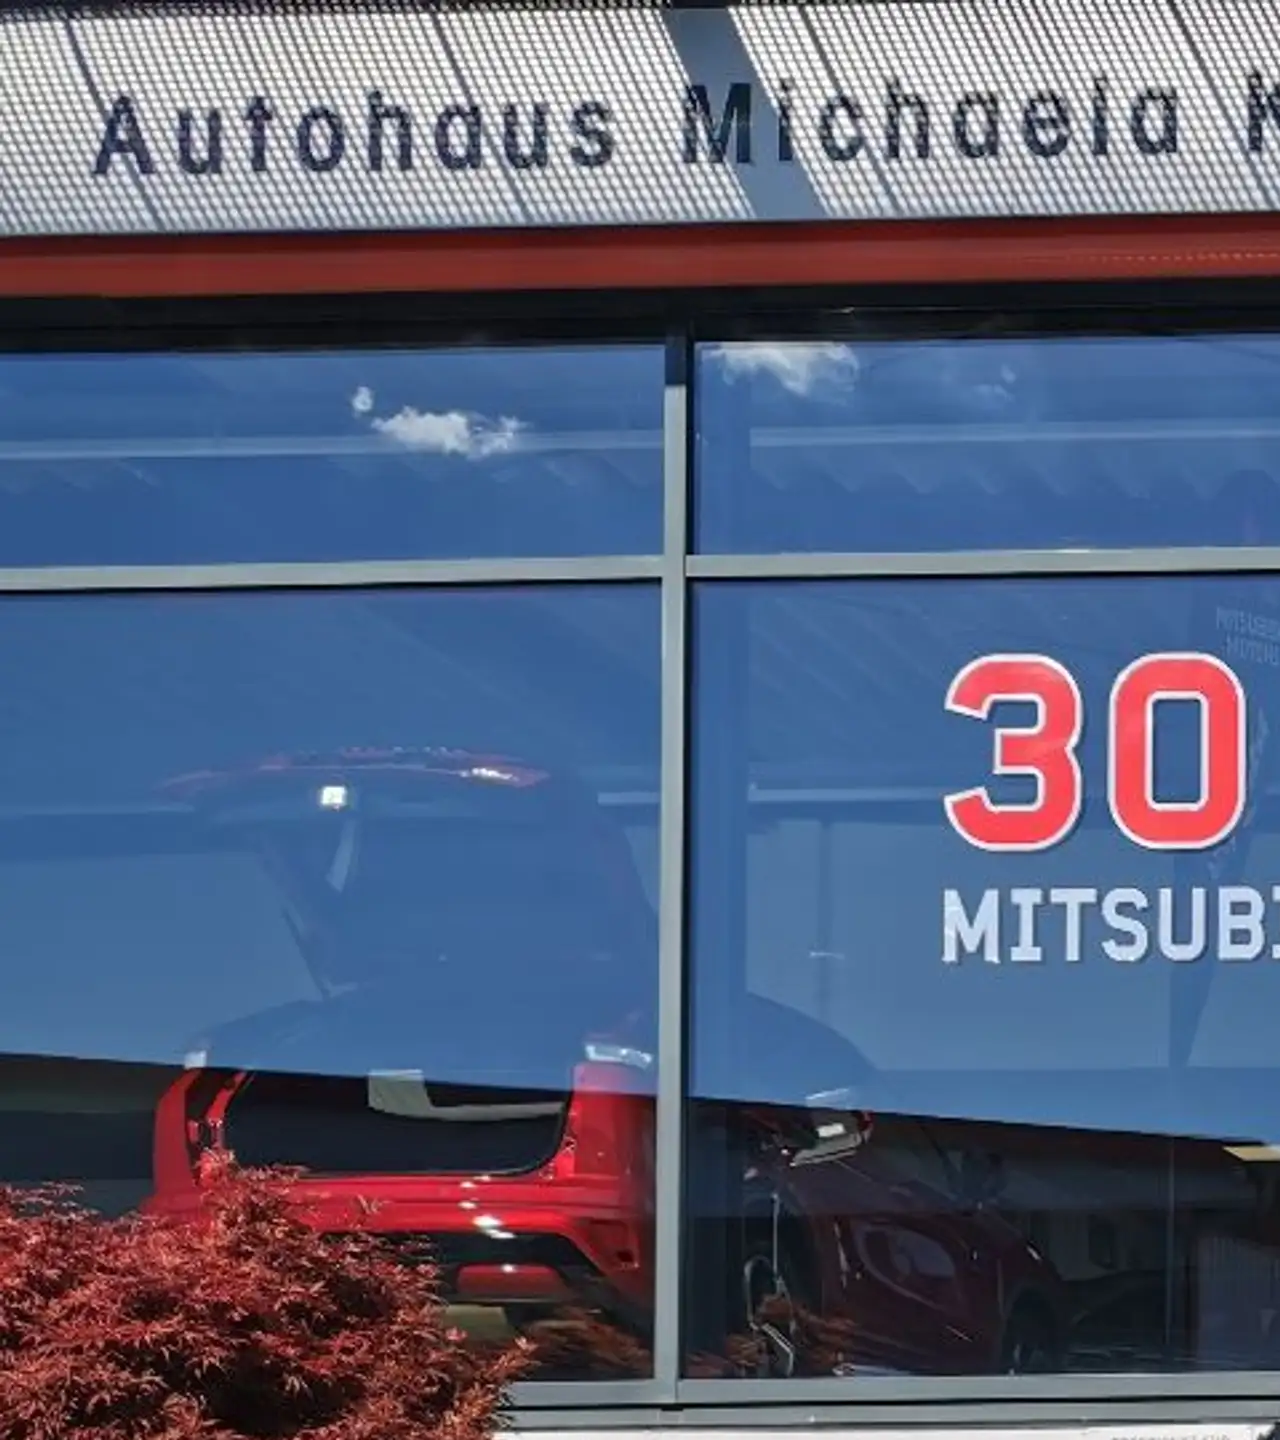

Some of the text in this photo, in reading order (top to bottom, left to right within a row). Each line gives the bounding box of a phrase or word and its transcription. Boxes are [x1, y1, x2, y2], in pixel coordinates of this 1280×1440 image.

[92, 88, 616, 176] Autohaus
[680, 78, 1184, 168] Michaela
[943, 651, 1248, 853] 30
